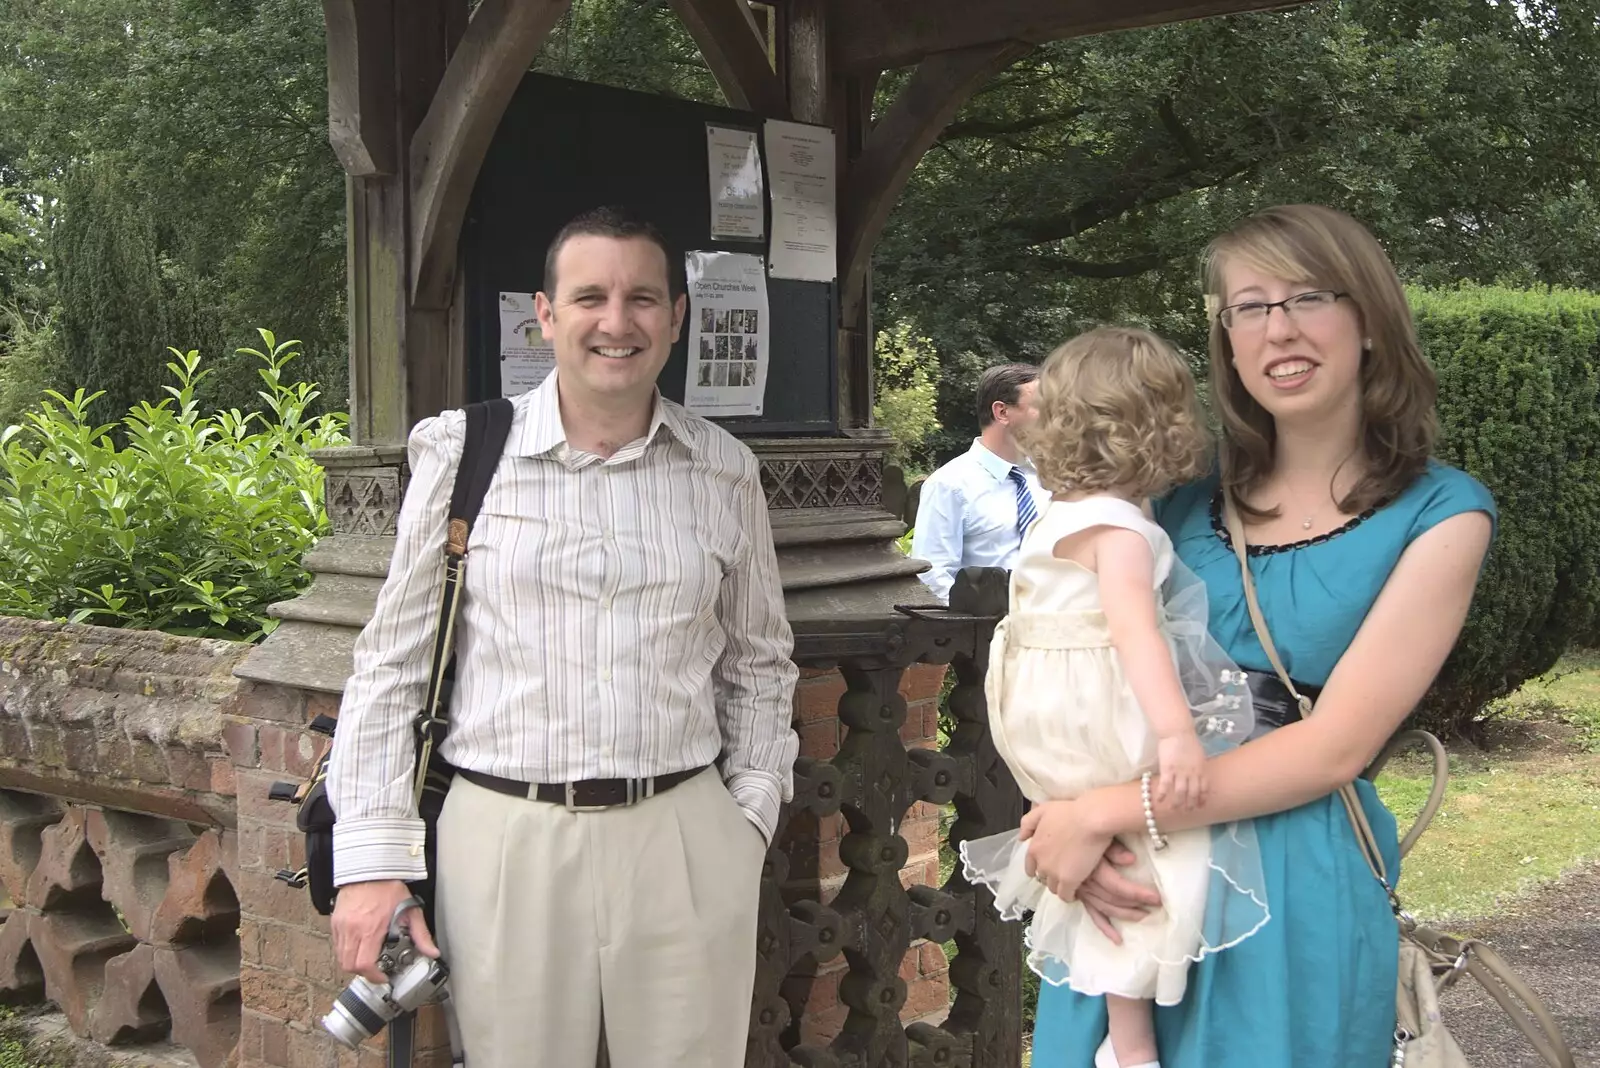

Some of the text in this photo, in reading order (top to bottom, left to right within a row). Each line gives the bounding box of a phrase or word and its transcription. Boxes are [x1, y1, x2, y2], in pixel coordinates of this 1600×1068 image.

[695, 281, 756, 292] Open Churches Week
